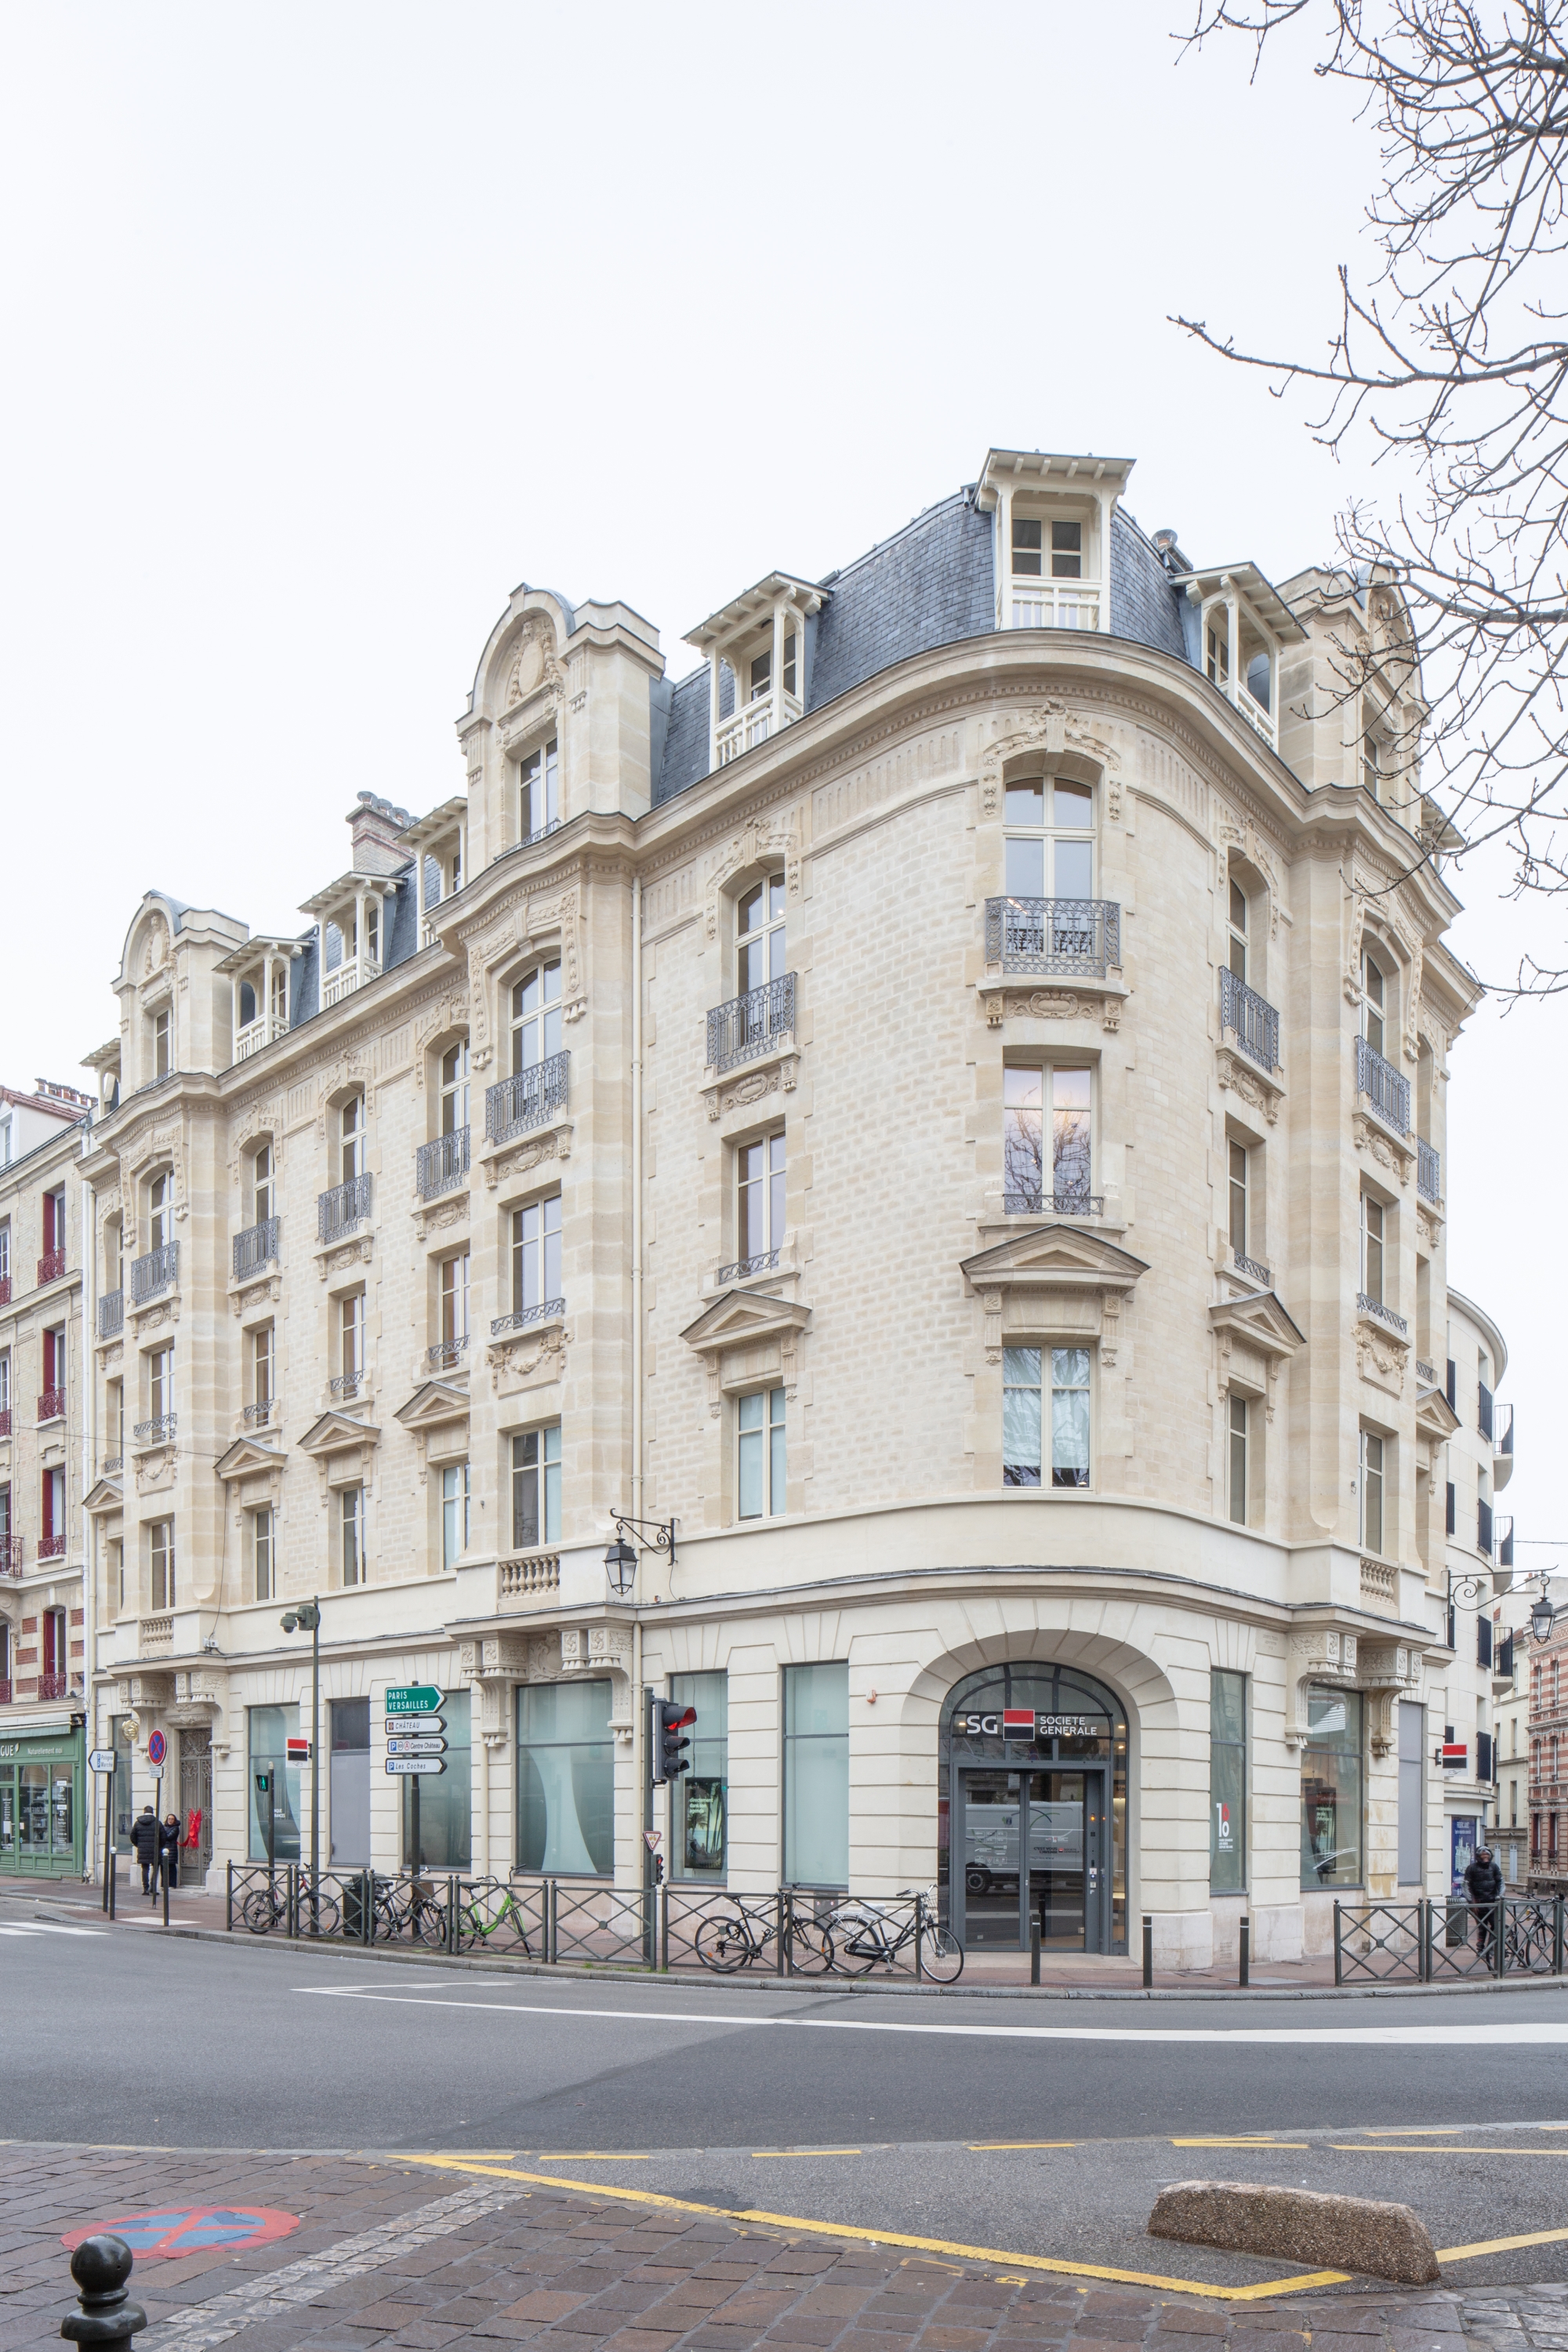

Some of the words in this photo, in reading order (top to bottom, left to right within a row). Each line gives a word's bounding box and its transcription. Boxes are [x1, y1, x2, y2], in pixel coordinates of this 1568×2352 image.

[388, 1691, 408, 1700] PARIS
[388, 1700, 428, 1710] VERSAILLES
[395, 1721, 420, 1730] CHÂTEAU
[967, 1715, 998, 1734] SG
[1040, 1716, 1086, 1726] SOCIETE
[1040, 1726, 1098, 1735] GENERALE
[0, 1745, 14, 1756] GUE
